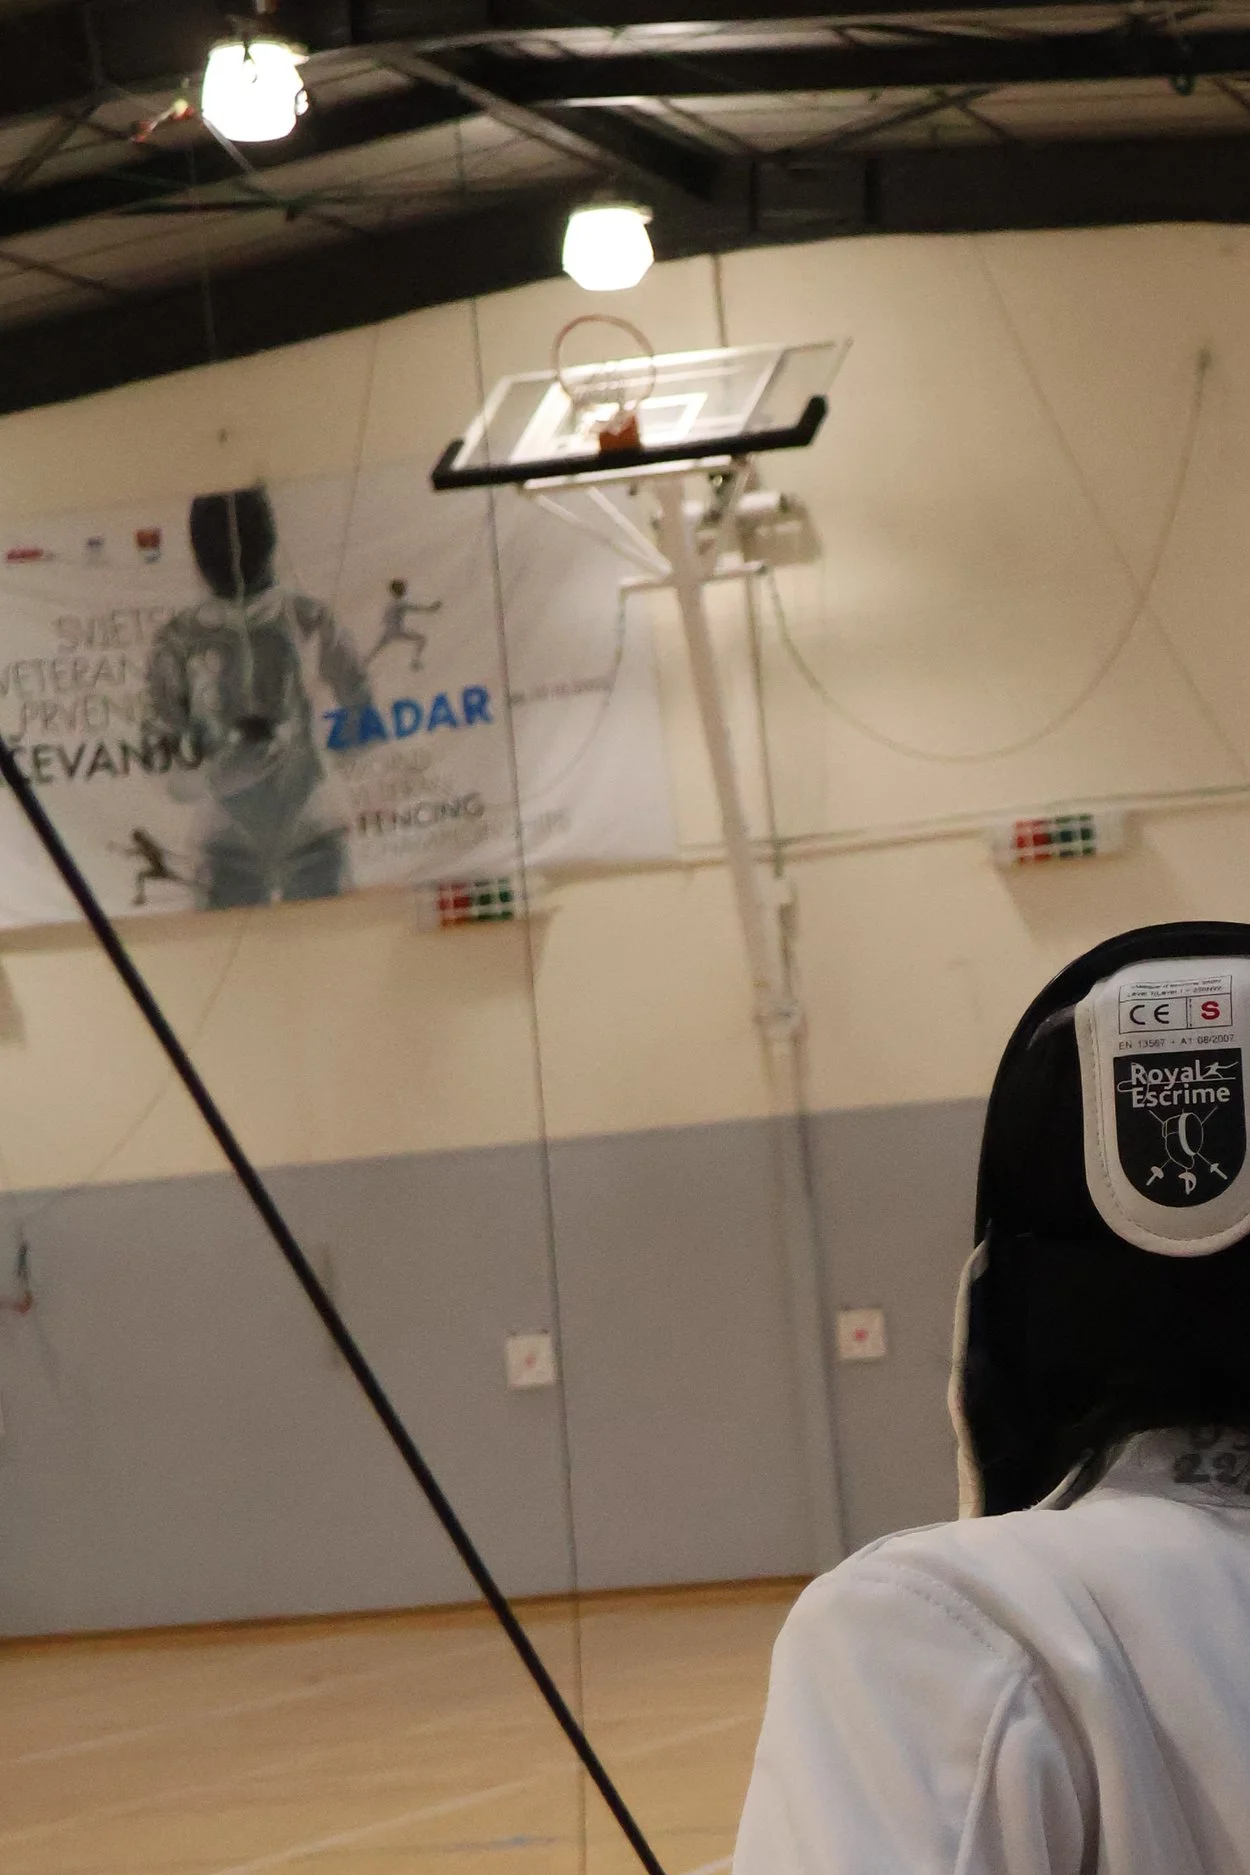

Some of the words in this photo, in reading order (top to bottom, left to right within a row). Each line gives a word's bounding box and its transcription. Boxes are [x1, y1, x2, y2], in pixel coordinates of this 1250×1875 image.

[322, 684, 494, 751] ZADAR
[1129, 1003, 1170, 1026] CE
[1200, 1000, 1221, 1021] S
[1118, 1041, 1133, 1051] EN
[1130, 1059, 1201, 1090] Royal
[1132, 1084, 1231, 1109] Escrime
